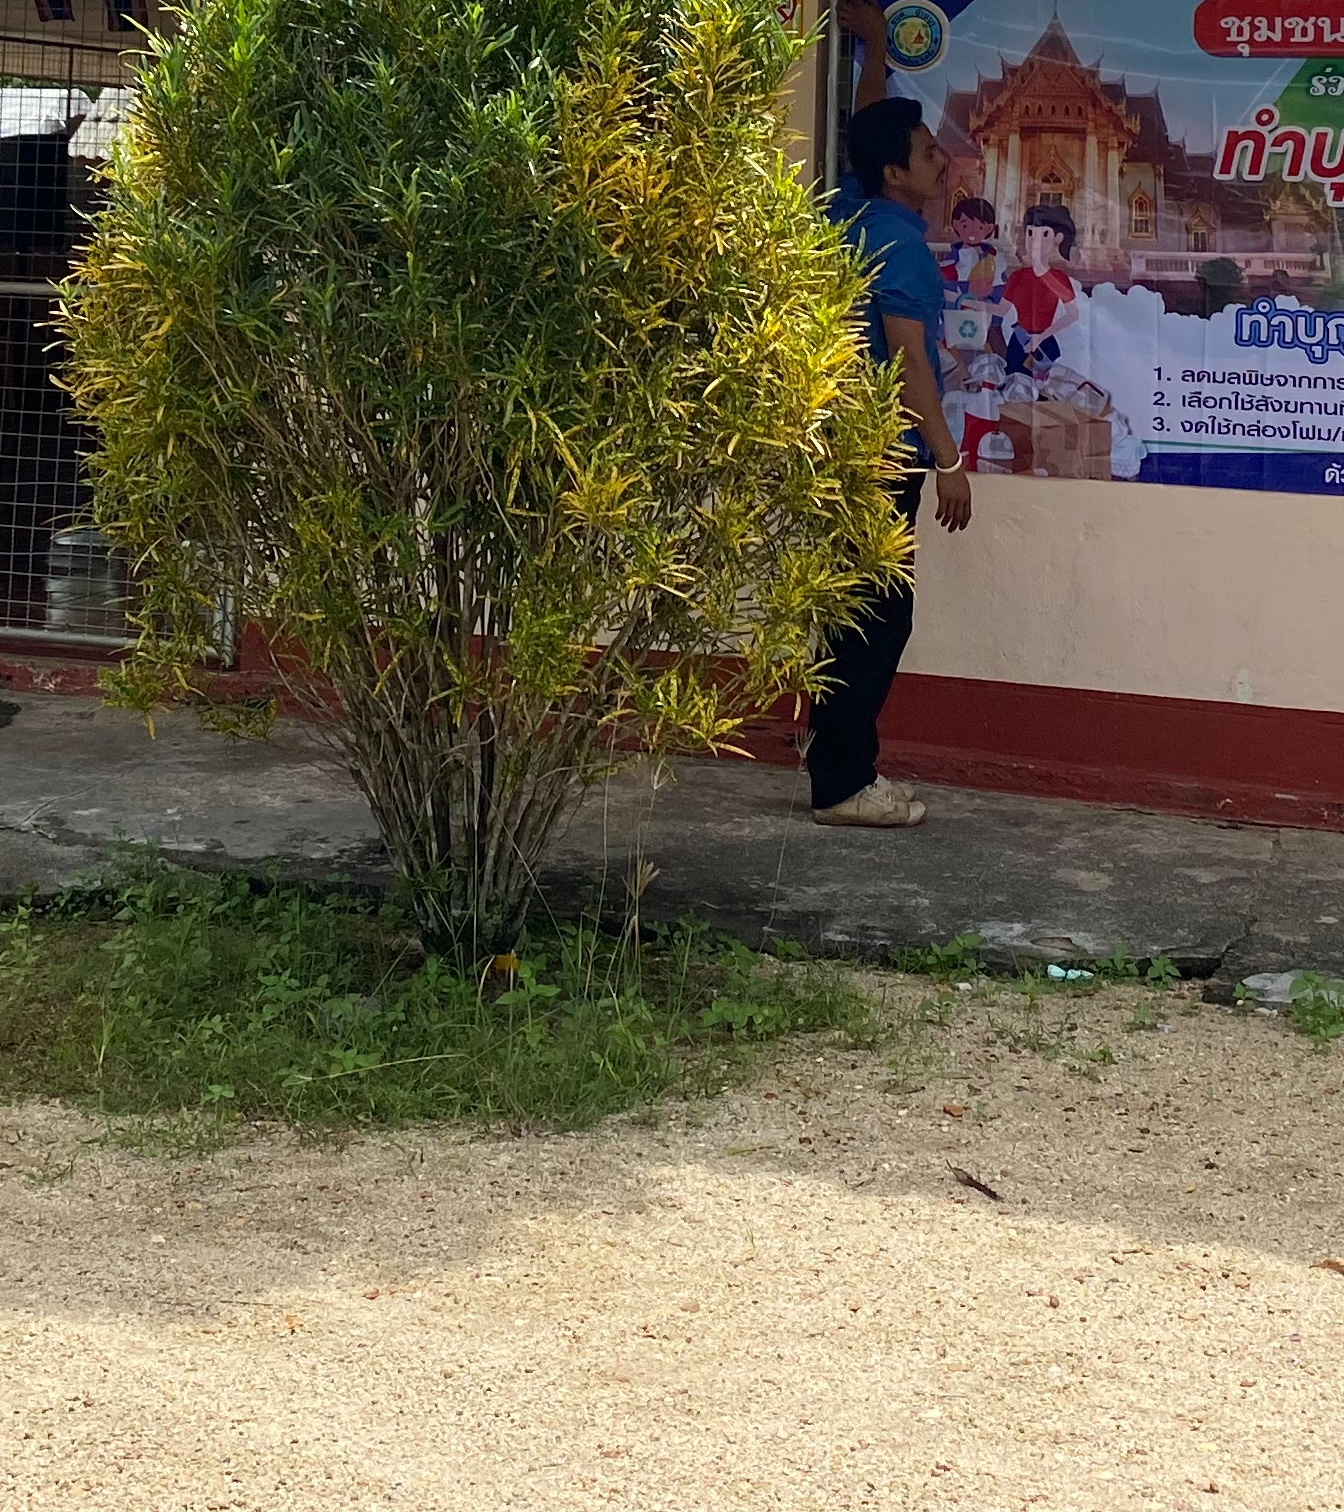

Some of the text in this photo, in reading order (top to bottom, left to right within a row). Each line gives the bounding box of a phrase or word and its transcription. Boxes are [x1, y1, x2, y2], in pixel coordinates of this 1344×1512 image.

[1152, 366, 1173, 383] 1.
[1151, 390, 1172, 408] 2.
[1151, 416, 1172, 433] 3.
